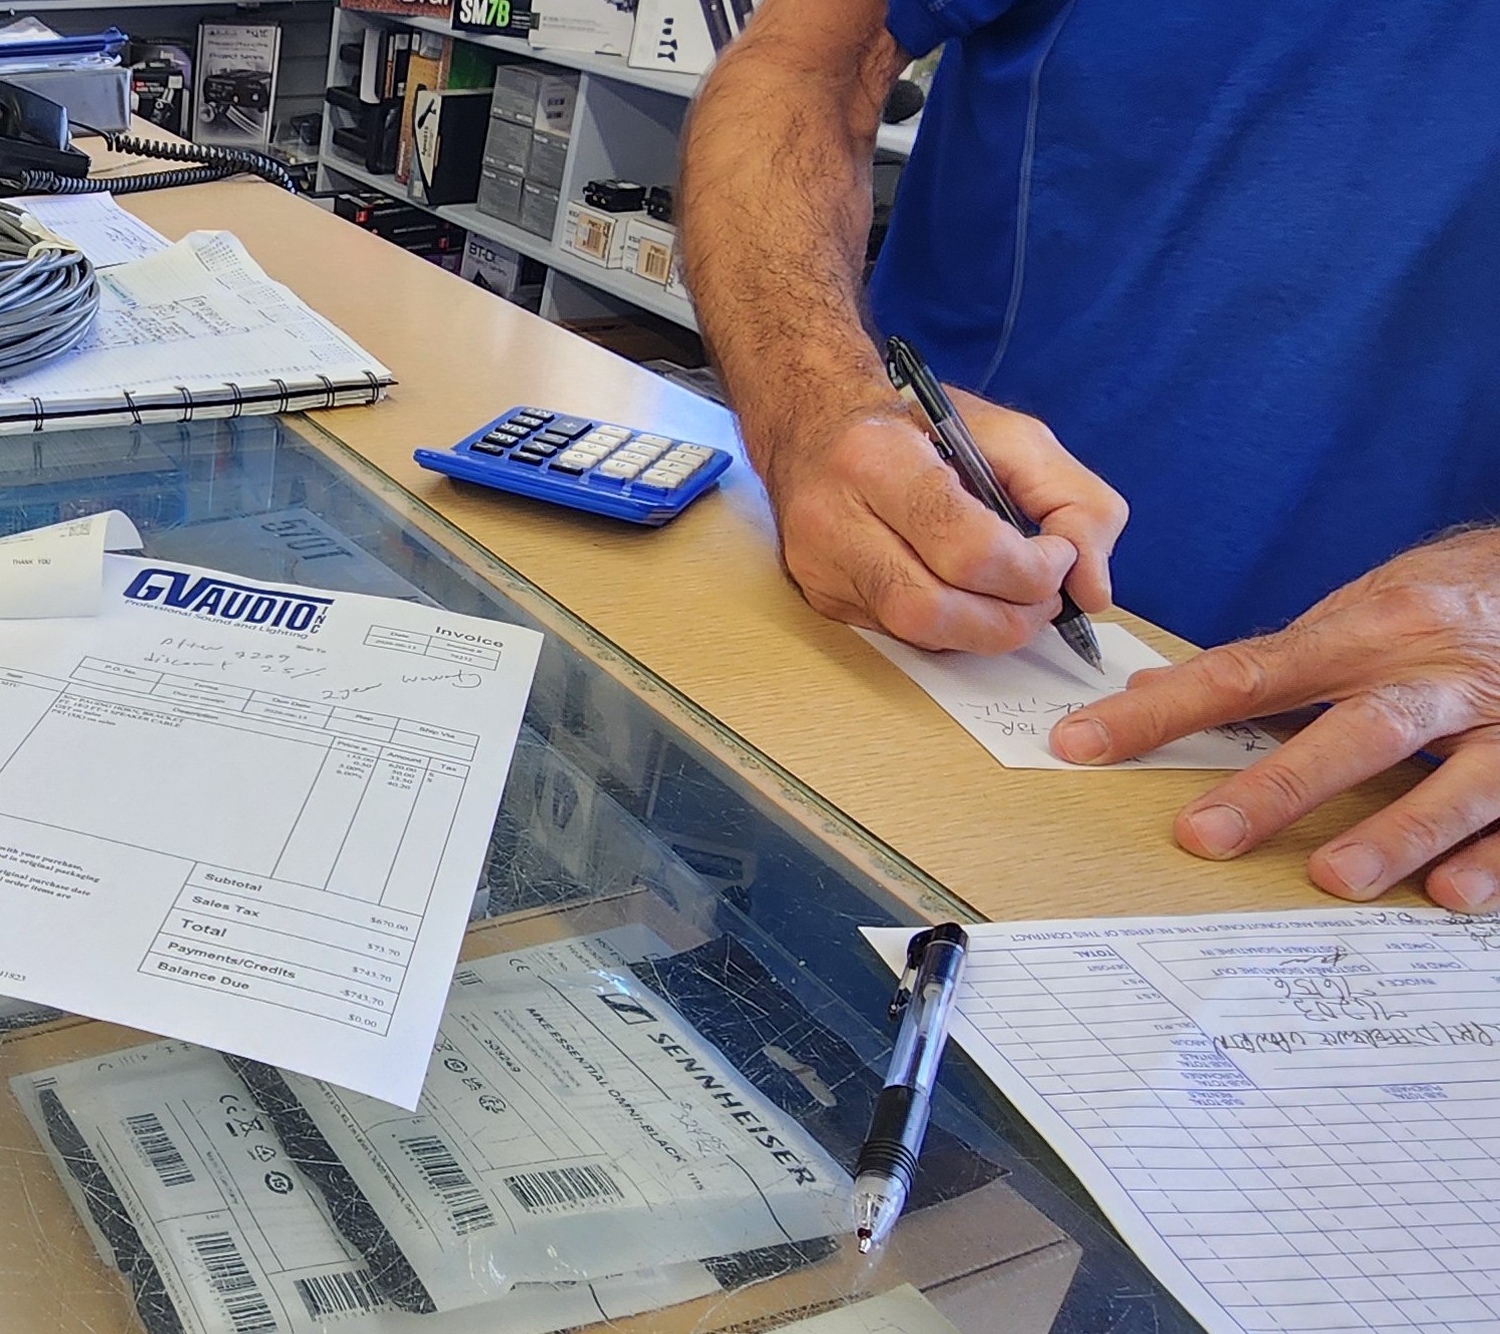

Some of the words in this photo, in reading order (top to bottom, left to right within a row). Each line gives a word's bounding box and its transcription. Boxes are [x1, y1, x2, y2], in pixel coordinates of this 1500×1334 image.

[12, 558, 34, 567] THANK
[37, 558, 52, 566] YOU
[123, 568, 334, 633] GVAUDIO
[124, 599, 193, 619] Professional
[195, 613, 232, 627] Sound
[232, 621, 255, 632] and
[257, 625, 311, 640] Lighting
[435, 626, 504, 648] Invoice
[387, 751, 422, 764] Amount
[441, 764, 457, 772] Tax
[54, 867, 101, 884] packaging
[204, 872, 263, 892] Subtotal
[371, 916, 409, 933] $670.00
[181, 918, 228, 938] Total
[352, 966, 392, 984] $743.70
[192, 895, 231, 911] Sales
[235, 904, 260, 918] Tax
[367, 942, 401, 958] $73.70
[1073, 949, 1115, 958] TOTAL
[157, 961, 217, 984] Balance
[220, 975, 250, 990] Due
[348, 1013, 378, 1028] $0.00
[167, 940, 296, 980] Payments/Credits
[339, 988, 385, 1007] -$743.70
[526, 1007, 553, 1035] MKE
[548, 1029, 608, 1087] ESSENTIAL
[608, 1087, 688, 1163] OMNI-BLACK
[646, 1032, 817, 1187] SENNHEISER
